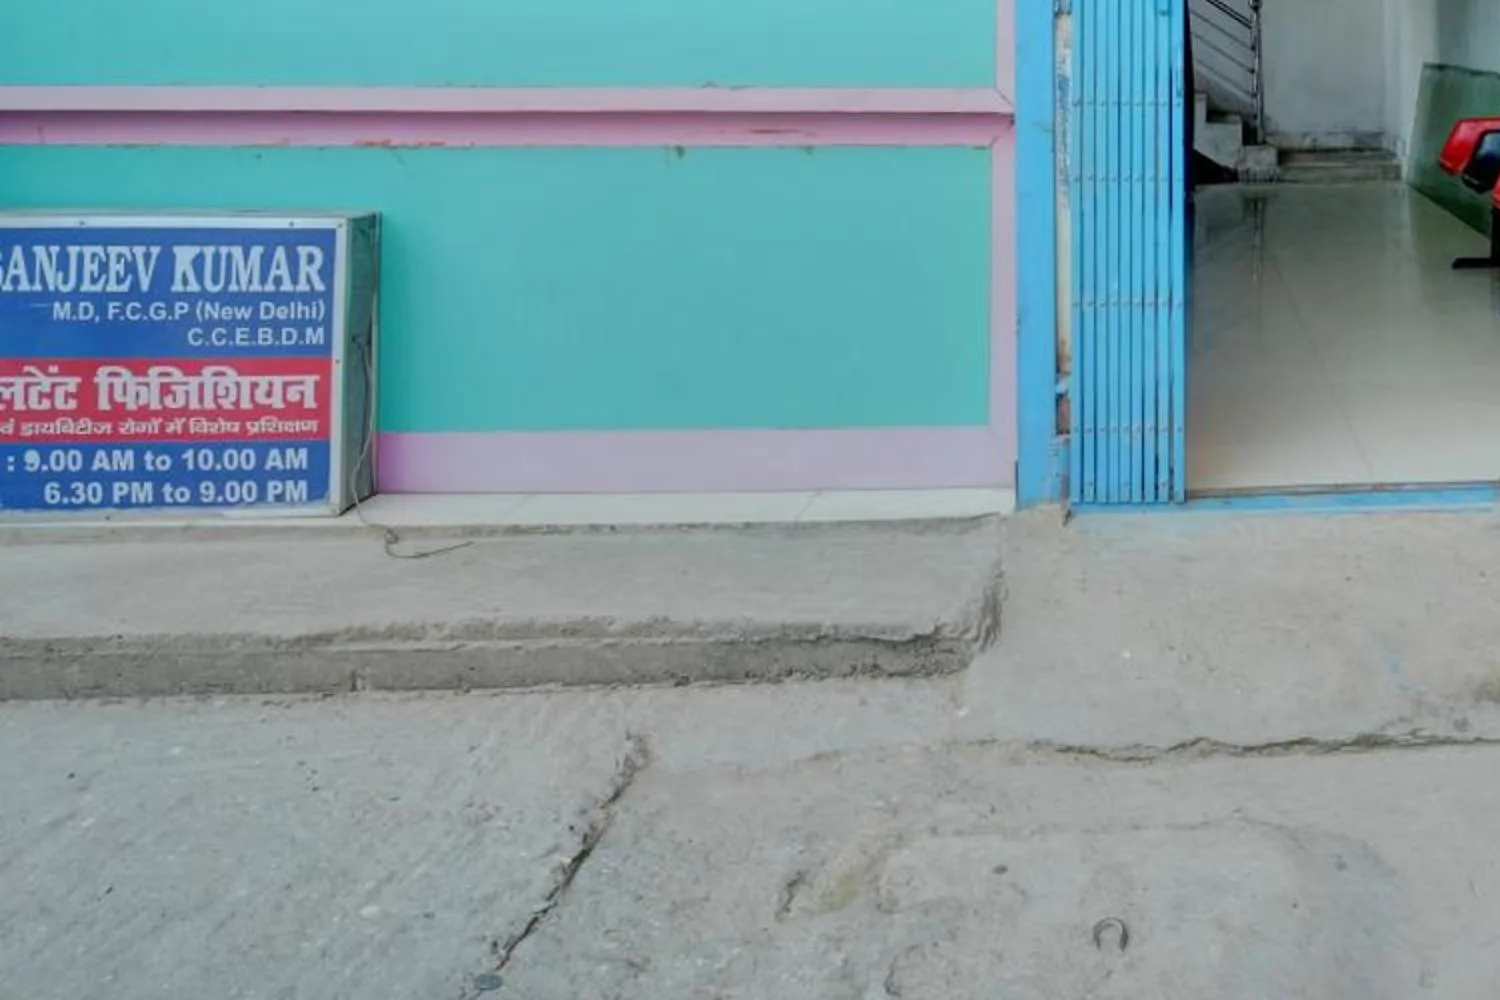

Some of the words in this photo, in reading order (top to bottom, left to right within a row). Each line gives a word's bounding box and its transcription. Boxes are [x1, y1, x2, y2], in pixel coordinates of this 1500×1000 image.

[0, 245, 161, 292] ANJEEV
[171, 245, 326, 292] KUMAR
[53, 301, 99, 323] M.D,
[107, 301, 189, 321] F.C.G.P
[196, 299, 252, 322] (New
[259, 299, 325, 322] Delhi)
[187, 327, 325, 346] C.C.E.B.D.M
[94, 365, 320, 411] फिजिशियन
[24, 449, 83, 472] 9.00
[92, 449, 135, 471] AM
[144, 451, 172, 471] to
[181, 449, 256, 471] 10.00
[265, 448, 308, 470] AM
[44, 481, 103, 505] 6.30
[112, 482, 153, 504] PM
[162, 482, 191, 503] to
[200, 481, 257, 503] 9.00
[267, 480, 308, 502] PM
